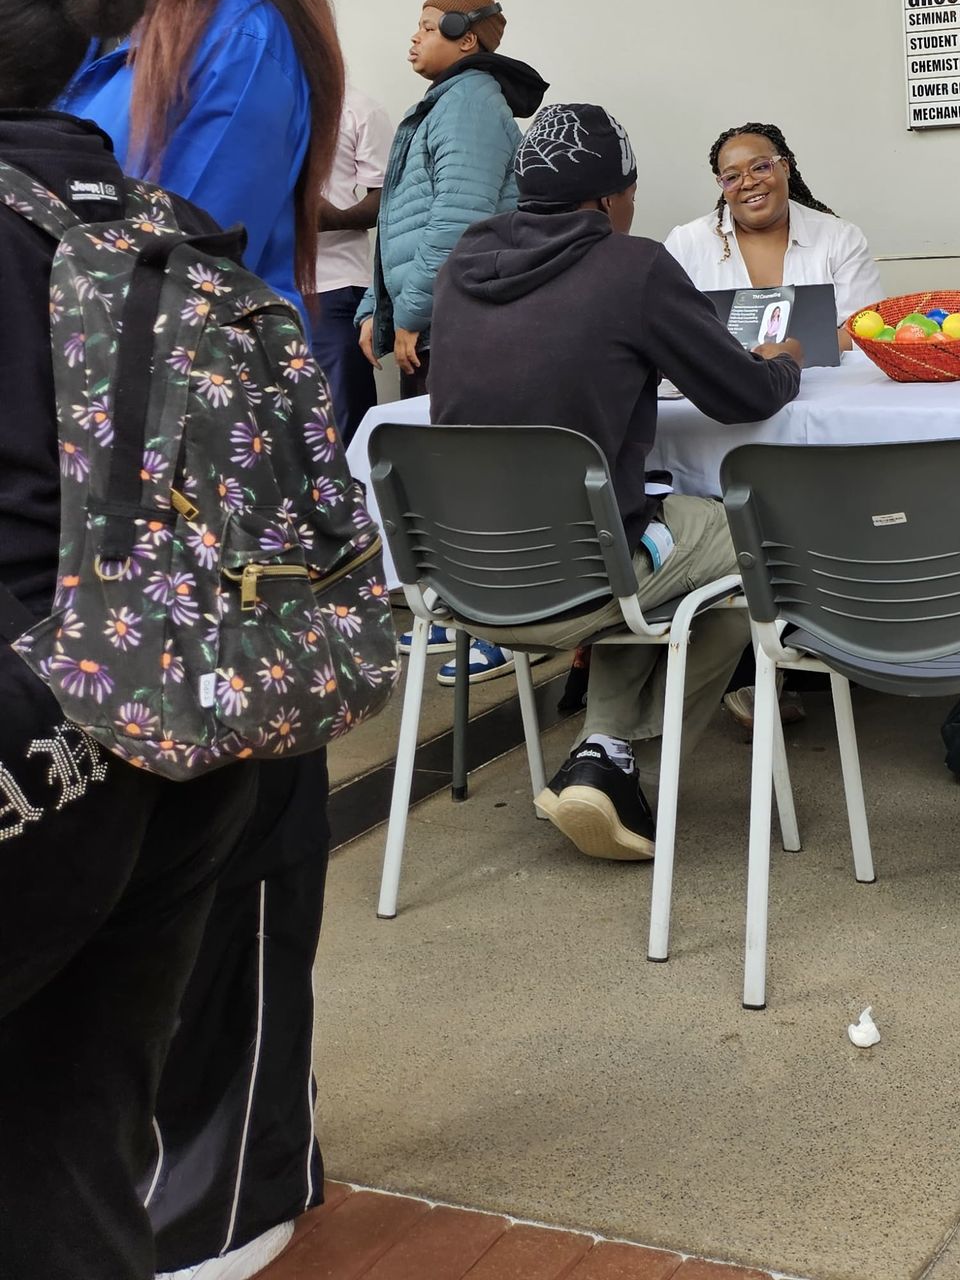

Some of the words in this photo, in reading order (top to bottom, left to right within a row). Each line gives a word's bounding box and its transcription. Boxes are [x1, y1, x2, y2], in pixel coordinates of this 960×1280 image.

[909, 10, 956, 26] SEMINAR
[910, 35, 957, 50] STUDENT
[912, 83, 948, 97] LOWER
